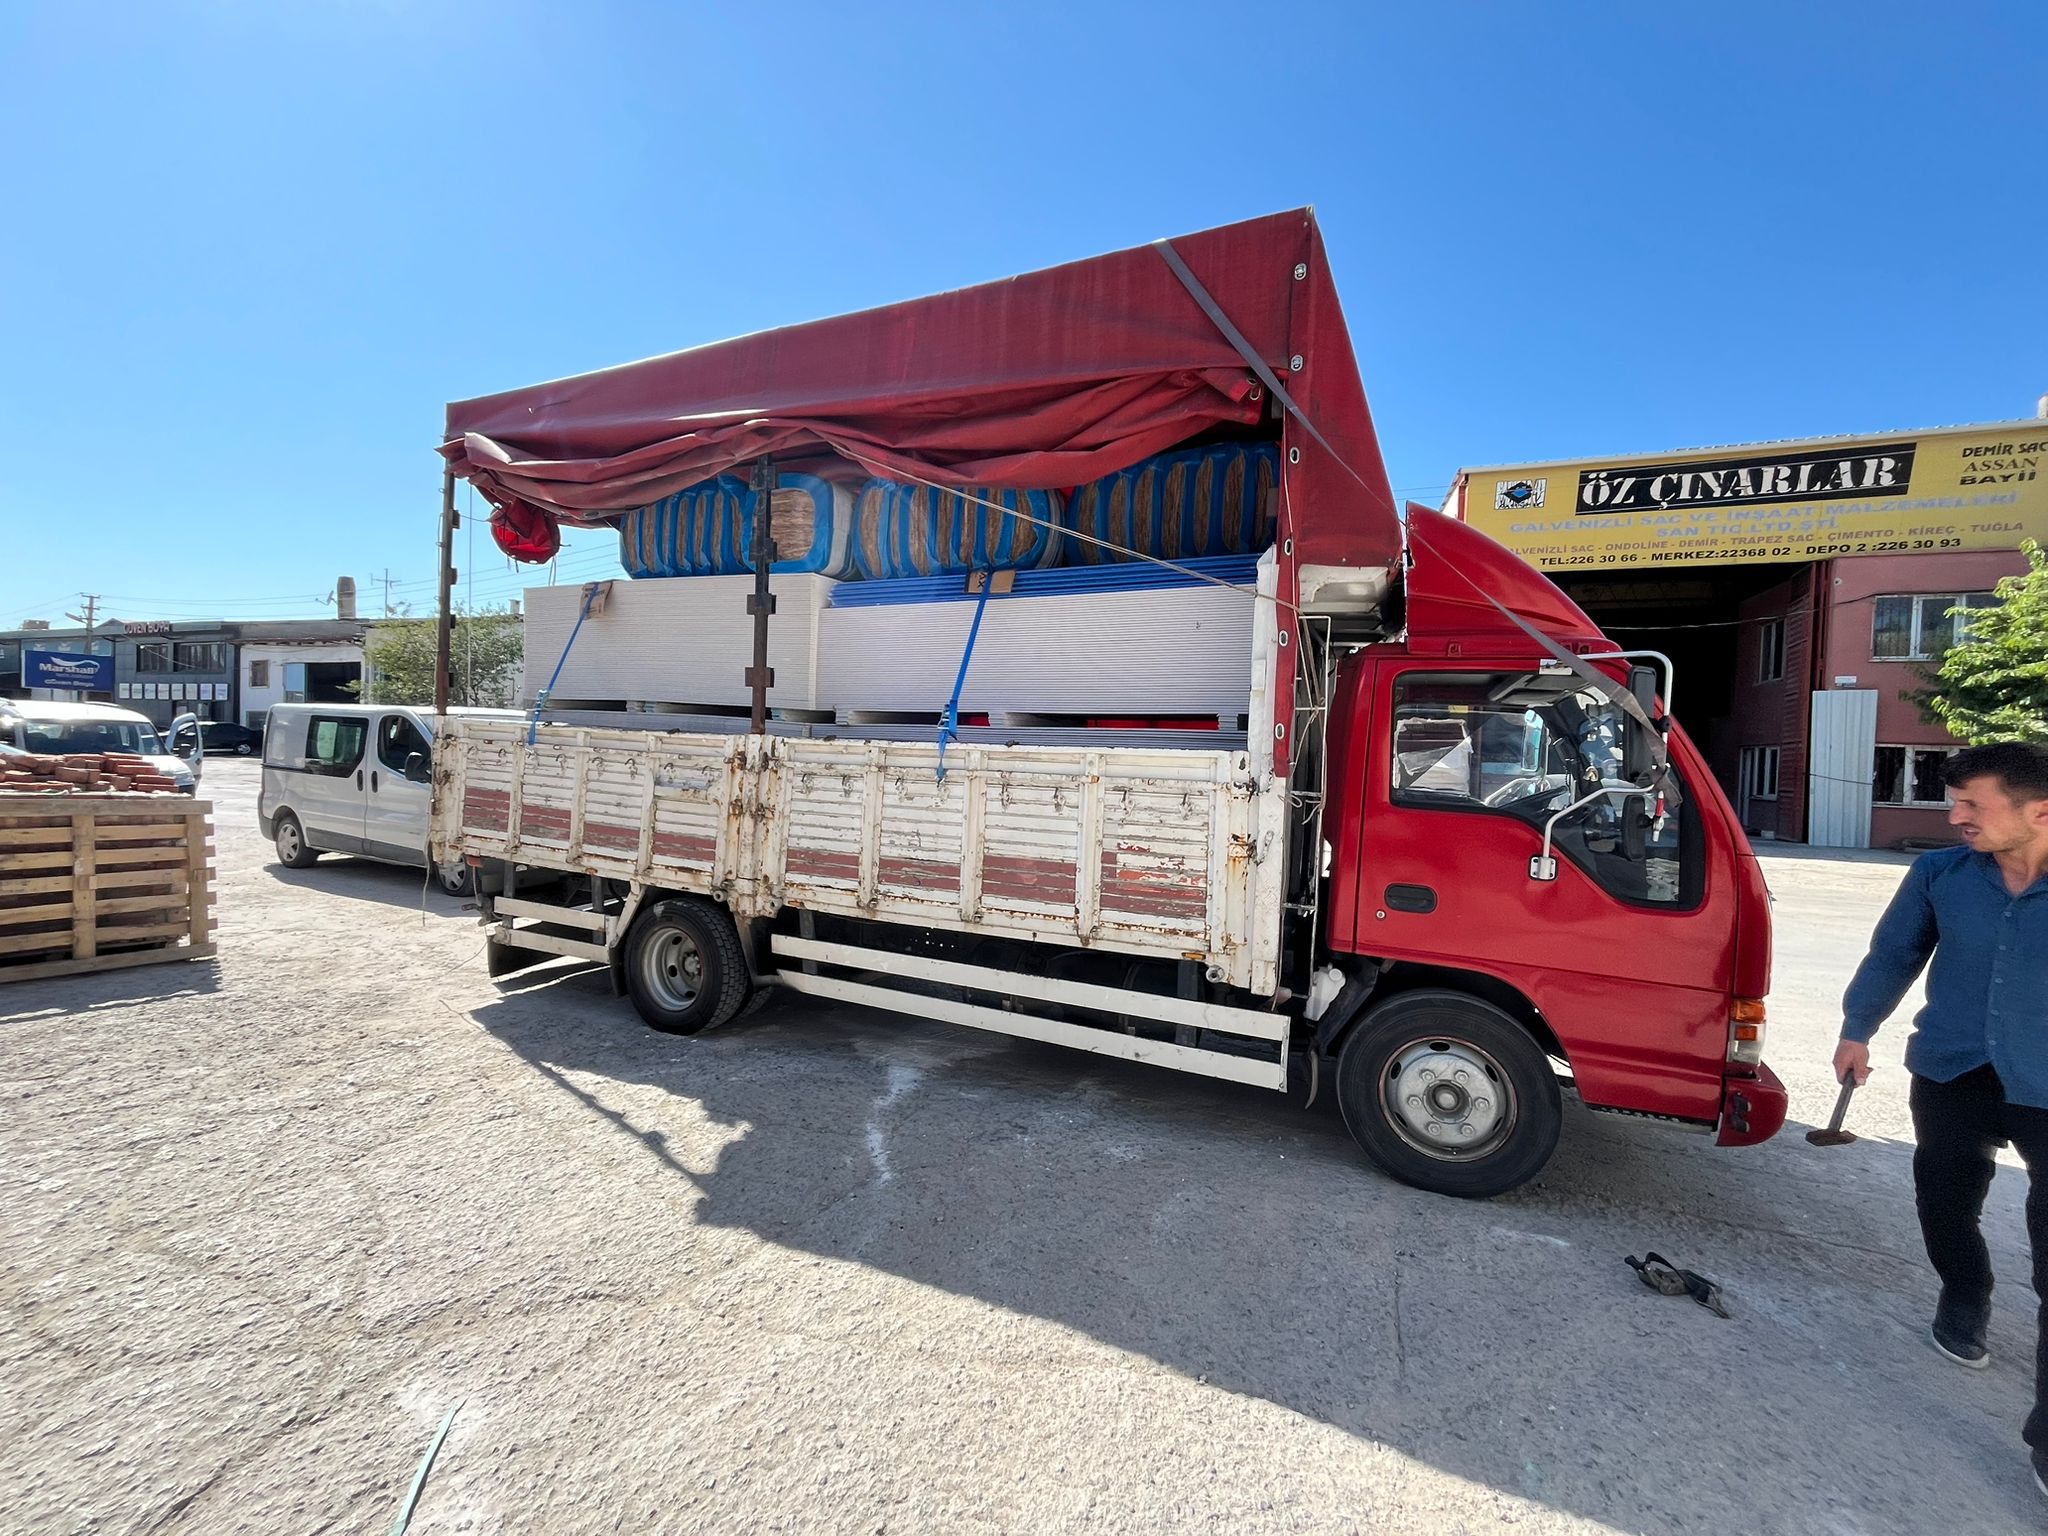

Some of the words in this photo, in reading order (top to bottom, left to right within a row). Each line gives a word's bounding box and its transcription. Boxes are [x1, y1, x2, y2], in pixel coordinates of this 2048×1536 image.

[1962, 442, 2014, 458] DEMİR
[1962, 456, 2040, 473] ASSAN
[1582, 471, 1635, 507] ÖZ
[1649, 457, 1897, 511] ÇINARLAR
[1640, 512, 1682, 526] SAC
[1689, 511, 1718, 523] VE
[1656, 525, 1699, 538] SAN
[1571, 544, 1595, 553] SAC
[1605, 540, 1669, 552] ONDOLİNE
[1679, 537, 1719, 549] DEMİR
[1730, 535, 1784, 546] TRAPEZ
[1787, 533, 1814, 544] SAC
[1540, 555, 1595, 566] TEL:226
[1599, 554, 1617, 564] 30
[1620, 553, 1639, 563] 66
[1651, 547, 1767, 562] MERKEZ:22368
[1771, 546, 1792, 557] 02
[1806, 544, 1851, 556] DEPO
[1856, 542, 1868, 553] 2
[1913, 539, 1935, 549] 30
[1939, 538, 1962, 548] 93
[39, 662, 97, 675] Marshall
